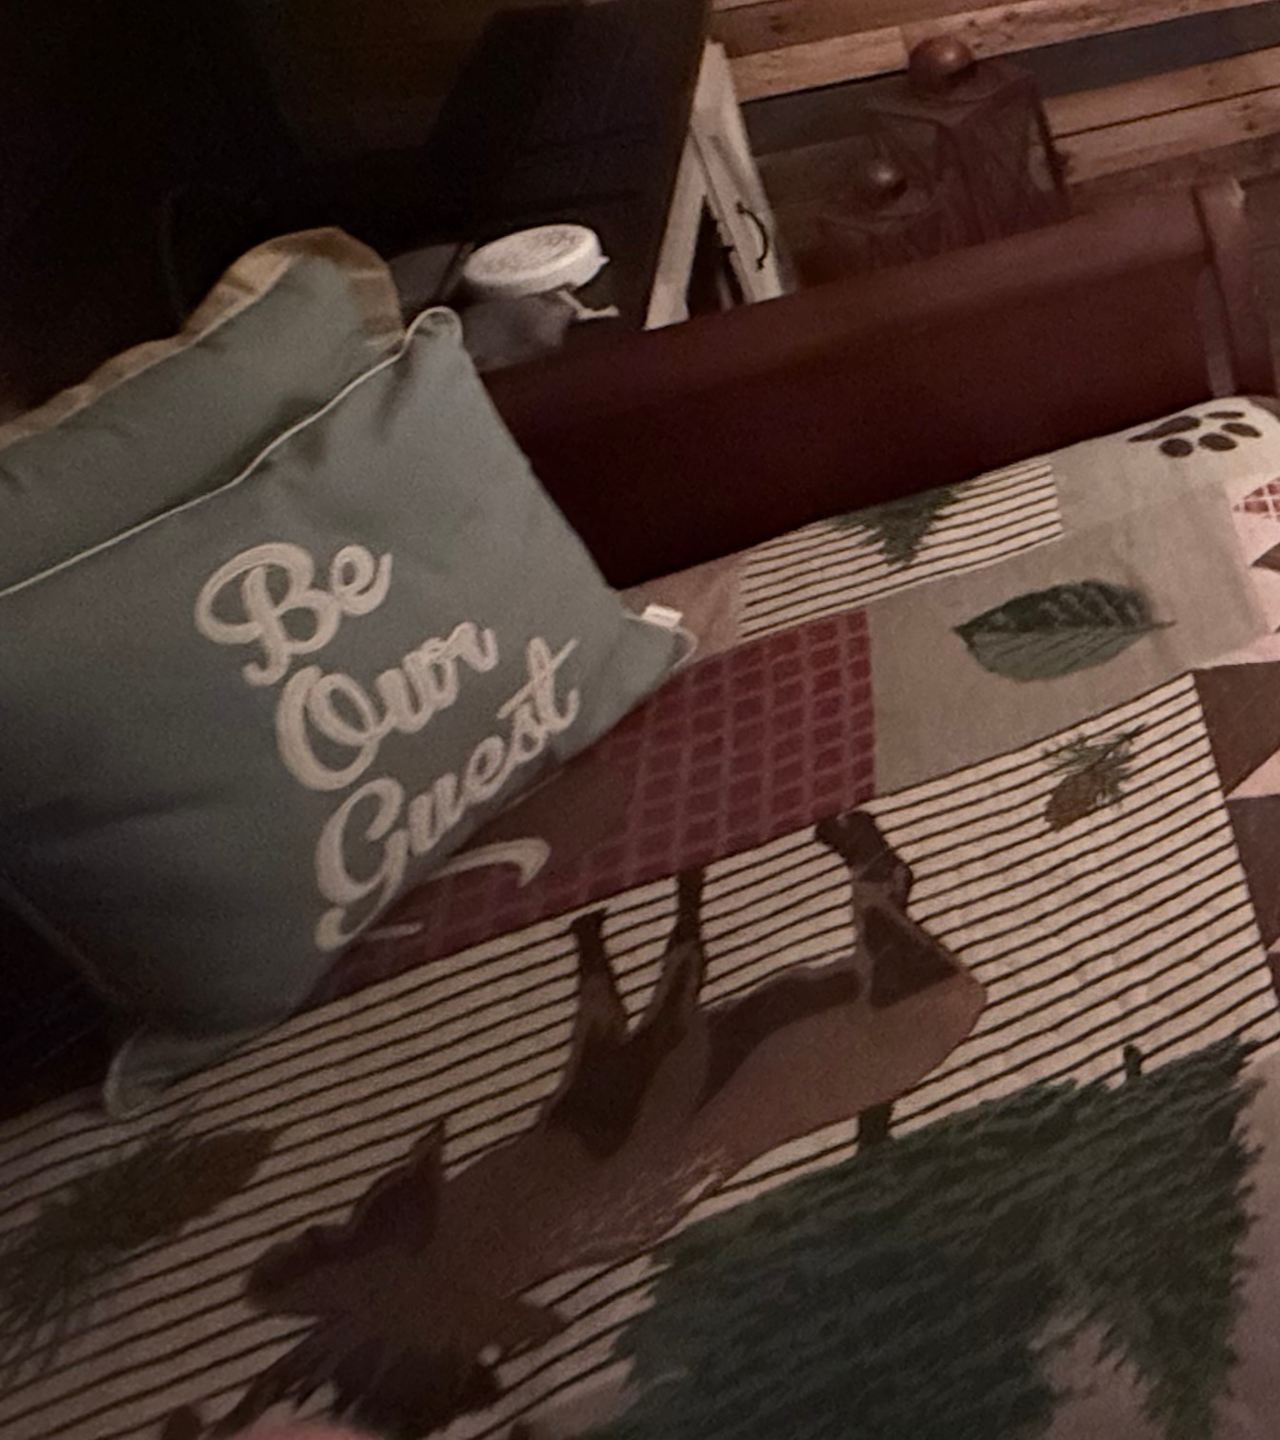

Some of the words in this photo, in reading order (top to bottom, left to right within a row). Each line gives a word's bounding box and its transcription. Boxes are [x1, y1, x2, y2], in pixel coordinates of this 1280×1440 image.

[195, 542, 393, 687] Be
[276, 620, 498, 792] Our
[313, 637, 580, 952] Guest
